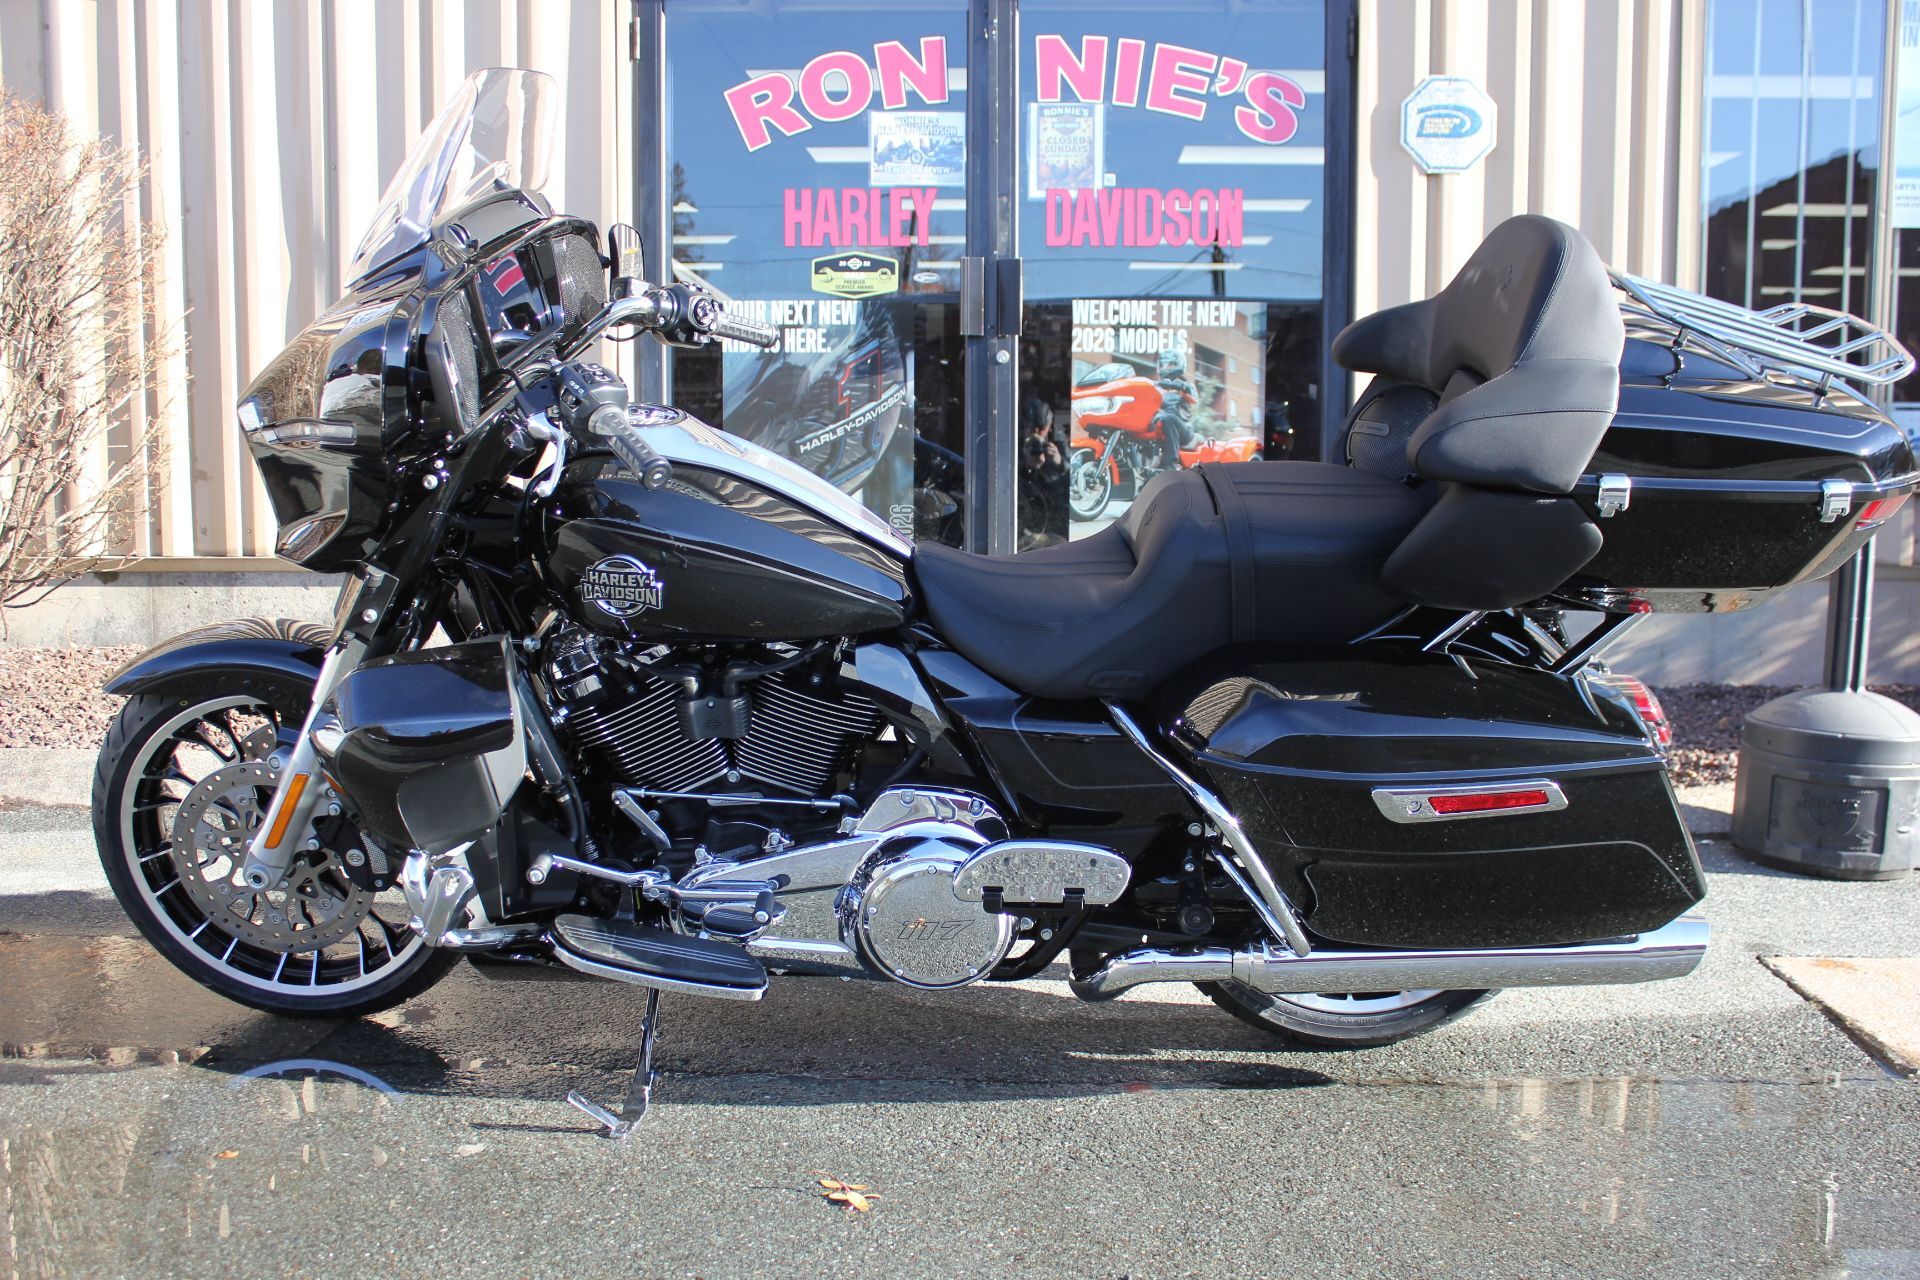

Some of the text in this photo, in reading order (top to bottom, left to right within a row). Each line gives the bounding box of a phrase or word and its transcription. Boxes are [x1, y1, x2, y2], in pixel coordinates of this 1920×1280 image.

[724, 35, 1306, 152] RON NIE'S
[1043, 106, 1089, 117] RONNIE'S
[1044, 145, 1089, 153] SUNDAYS
[1046, 136, 1086, 145] CLOSED
[784, 187, 1243, 248] HARLEY DAVIDSON
[770, 300, 815, 325] NEXT
[819, 300, 857, 325] NEW
[1072, 299, 1237, 327] WELCOME THE NEW
[784, 328, 832, 353] HERE.
[1071, 327, 1192, 354] 2026 MODELS.
[800, 387, 906, 454] HARLEY-DAVIDSON
[889, 504, 914, 540] 026
[584, 583, 657, 606] DAVIDSON
[898, 919, 976, 940] 117
